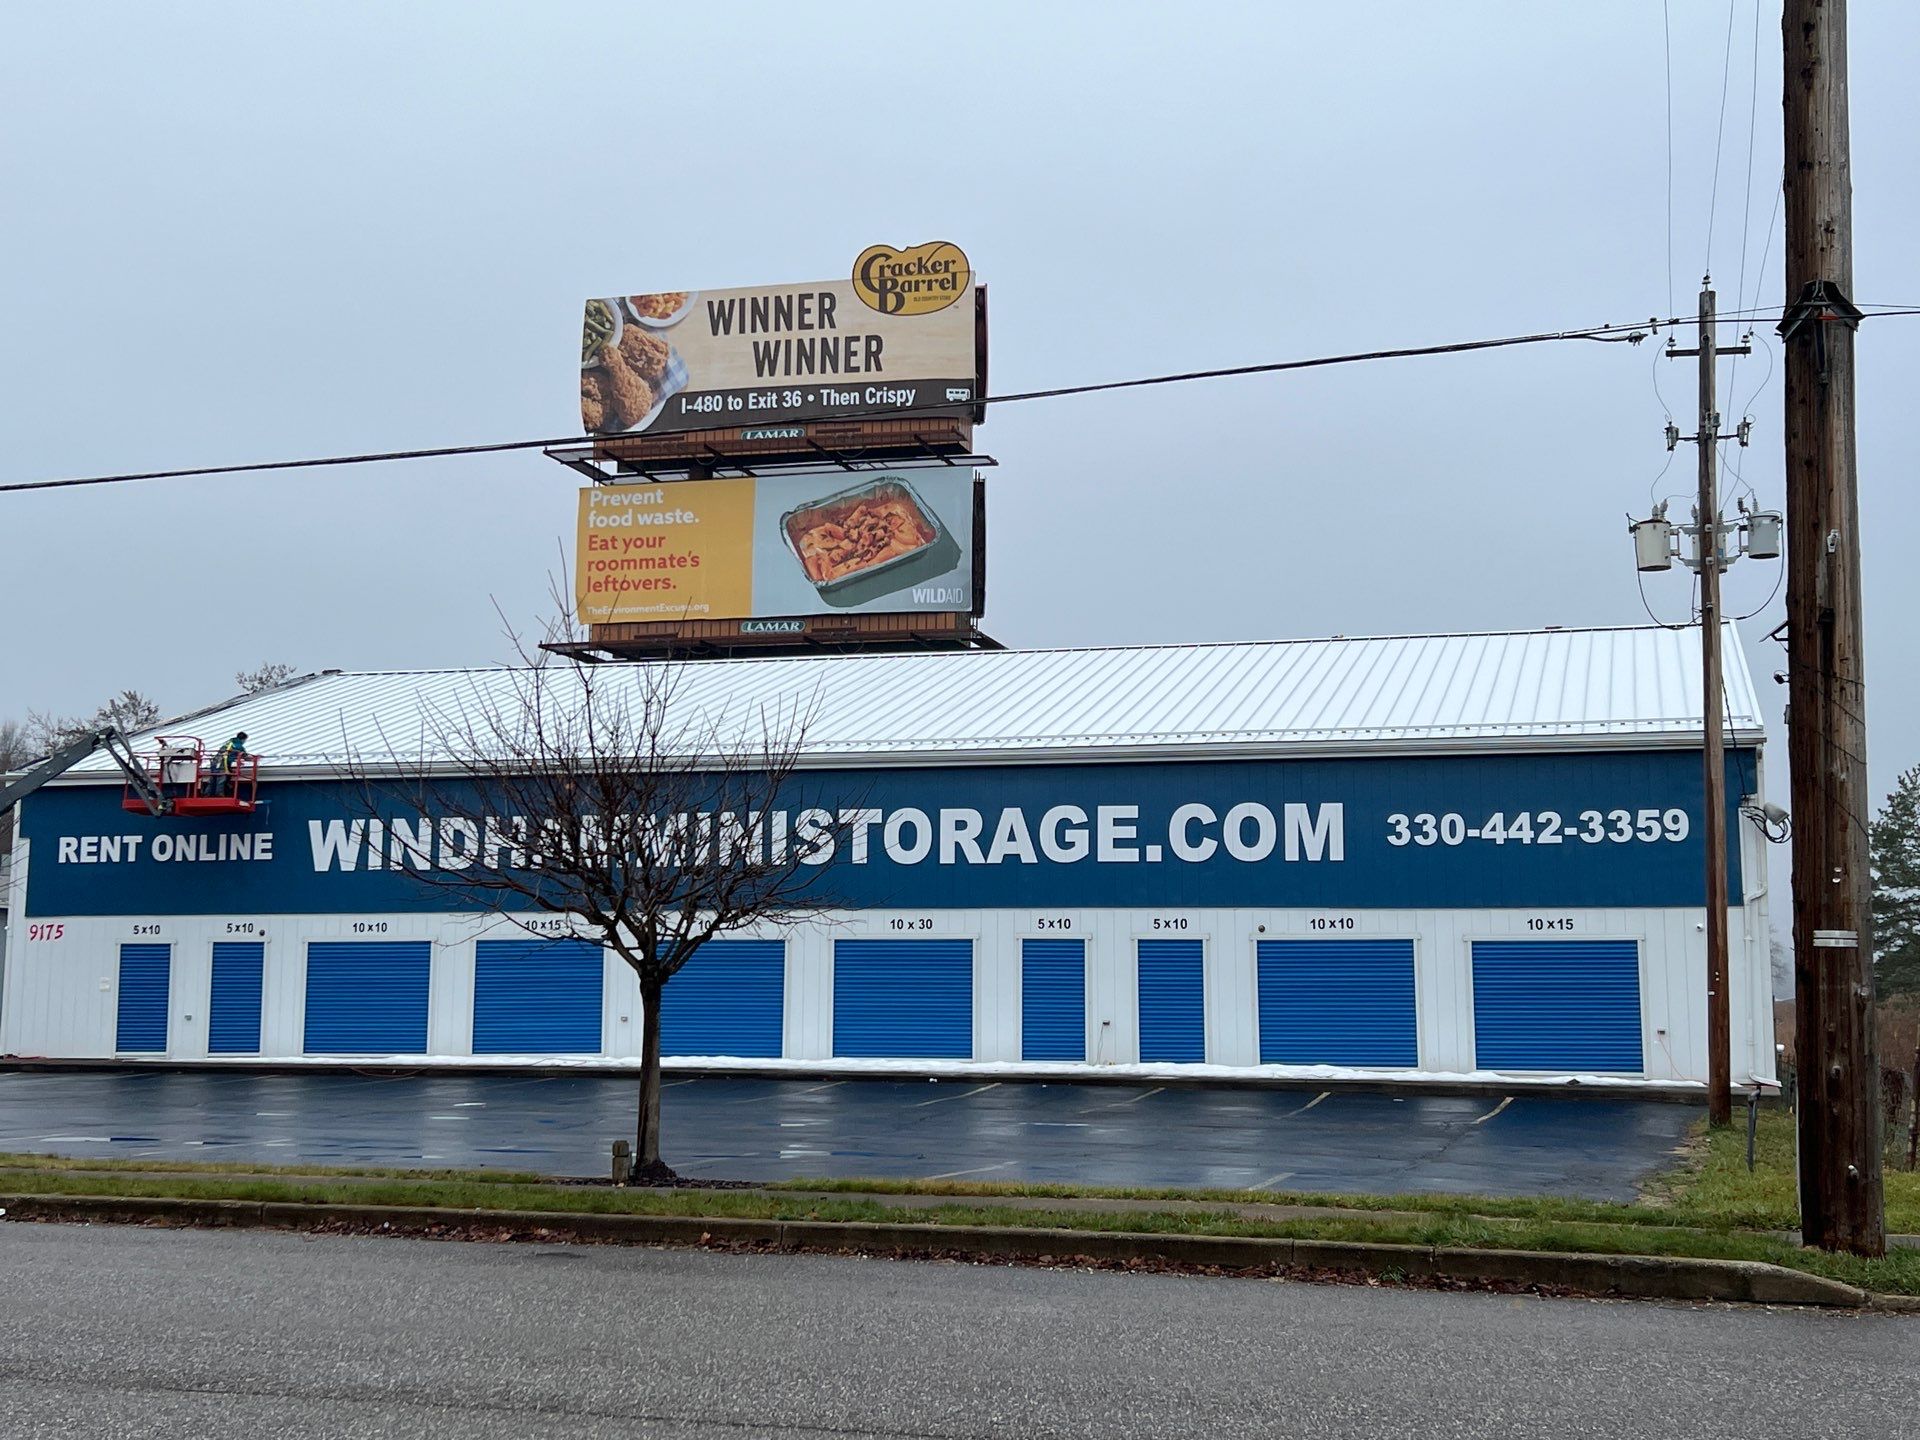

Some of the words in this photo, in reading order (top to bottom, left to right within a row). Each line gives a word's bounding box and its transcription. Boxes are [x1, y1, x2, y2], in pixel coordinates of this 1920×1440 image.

[861, 253, 956, 293] Cracker
[878, 272, 957, 314] Barrel
[707, 292, 837, 336] WINNER
[752, 334, 883, 378] WINNER
[681, 395, 723, 414] I-480
[727, 395, 743, 411] to
[748, 391, 778, 409] Exit
[782, 390, 802, 407] 36
[820, 388, 860, 406] Then
[865, 386, 916, 407] Crispy
[746, 429, 799, 440] LAMAR
[590, 489, 664, 508] Prevent
[588, 509, 633, 529] food
[637, 508, 700, 526] waste.
[588, 534, 618, 551] Eat
[622, 535, 666, 554] your
[587, 574, 677, 593] leftovers.
[586, 602, 710, 616] TheEnvironmentExcuse.org
[746, 621, 800, 632] LAMAR
[1386, 807, 1690, 846] 330-442-3359
[57, 835, 144, 864] RENT
[150, 832, 274, 863] ONLINE
[29, 924, 65, 941] 9175
